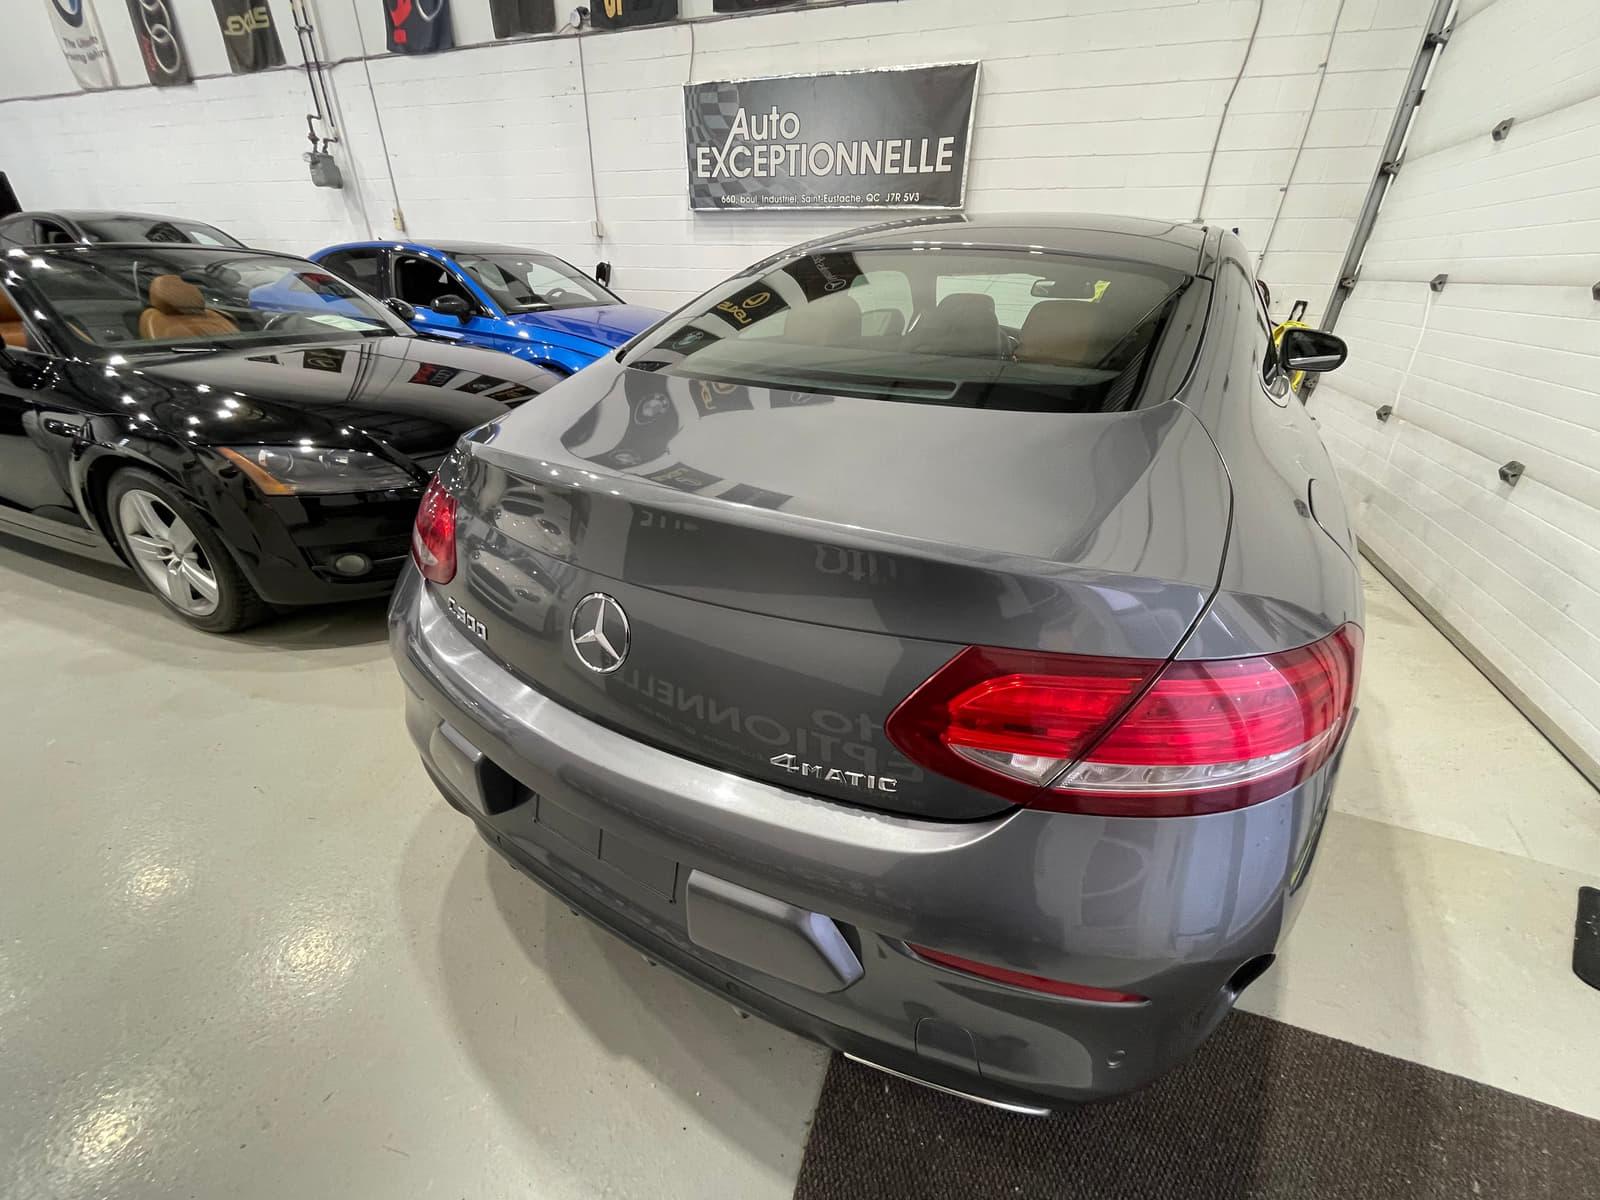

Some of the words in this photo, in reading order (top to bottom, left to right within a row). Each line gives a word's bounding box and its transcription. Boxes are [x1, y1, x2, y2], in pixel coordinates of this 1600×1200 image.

[728, 105, 800, 142] Auto
[696, 137, 954, 178] EXCEPTIONNELLE
[801, 194, 865, 204] Sant-Eustache,
[866, 193, 880, 203] QC
[885, 193, 901, 202] J7R
[903, 192, 920, 202] 5V3
[769, 753, 898, 792] 4MATIC
